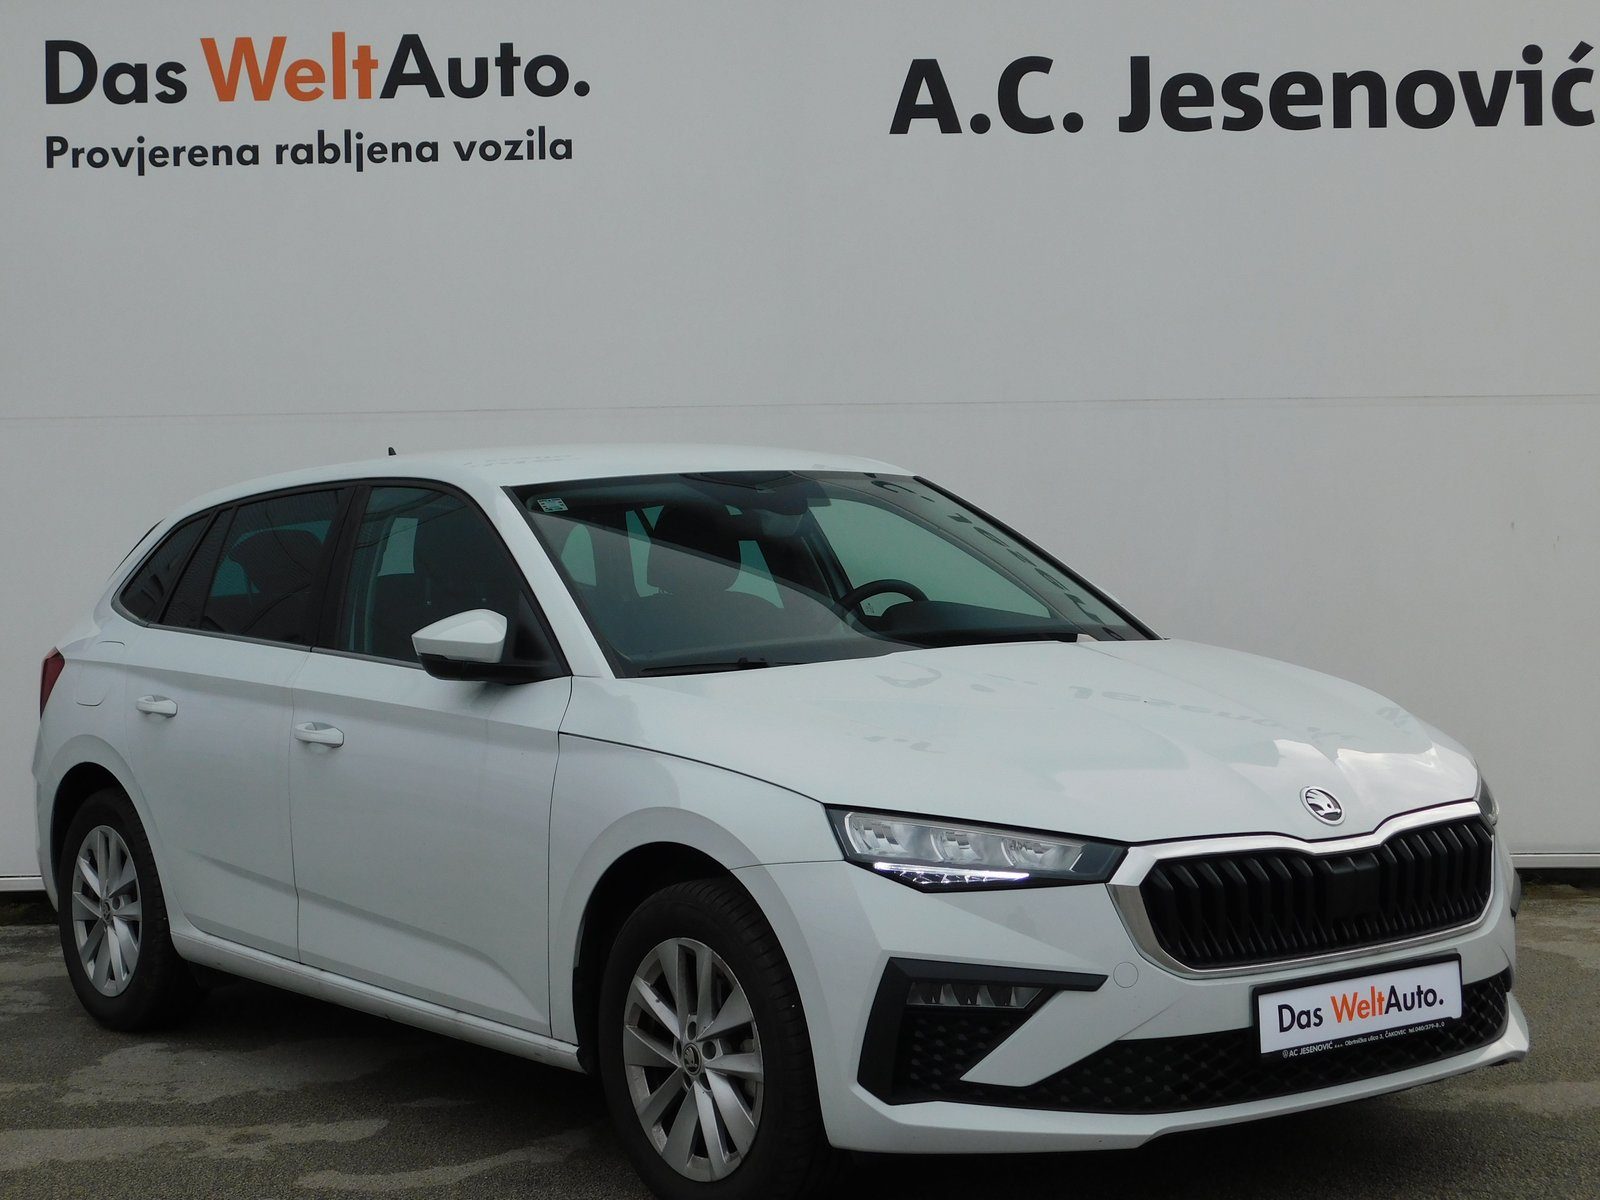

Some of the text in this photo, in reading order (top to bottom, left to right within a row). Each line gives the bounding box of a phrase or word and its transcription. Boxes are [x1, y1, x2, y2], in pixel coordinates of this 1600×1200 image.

[45, 32, 590, 105] Das WeltAuto.
[889, 41, 1595, 134] A.C. Jesenović
[46, 126, 572, 176] Provjerena rabljena vozila
[1278, 985, 1444, 1033] Das WeltAuto.
[1288, 1048, 1299, 1057] AC
[1299, 1040, 1333, 1055] JESENOVIĆ
[1384, 1029, 1407, 1038] ČAKOVEC
